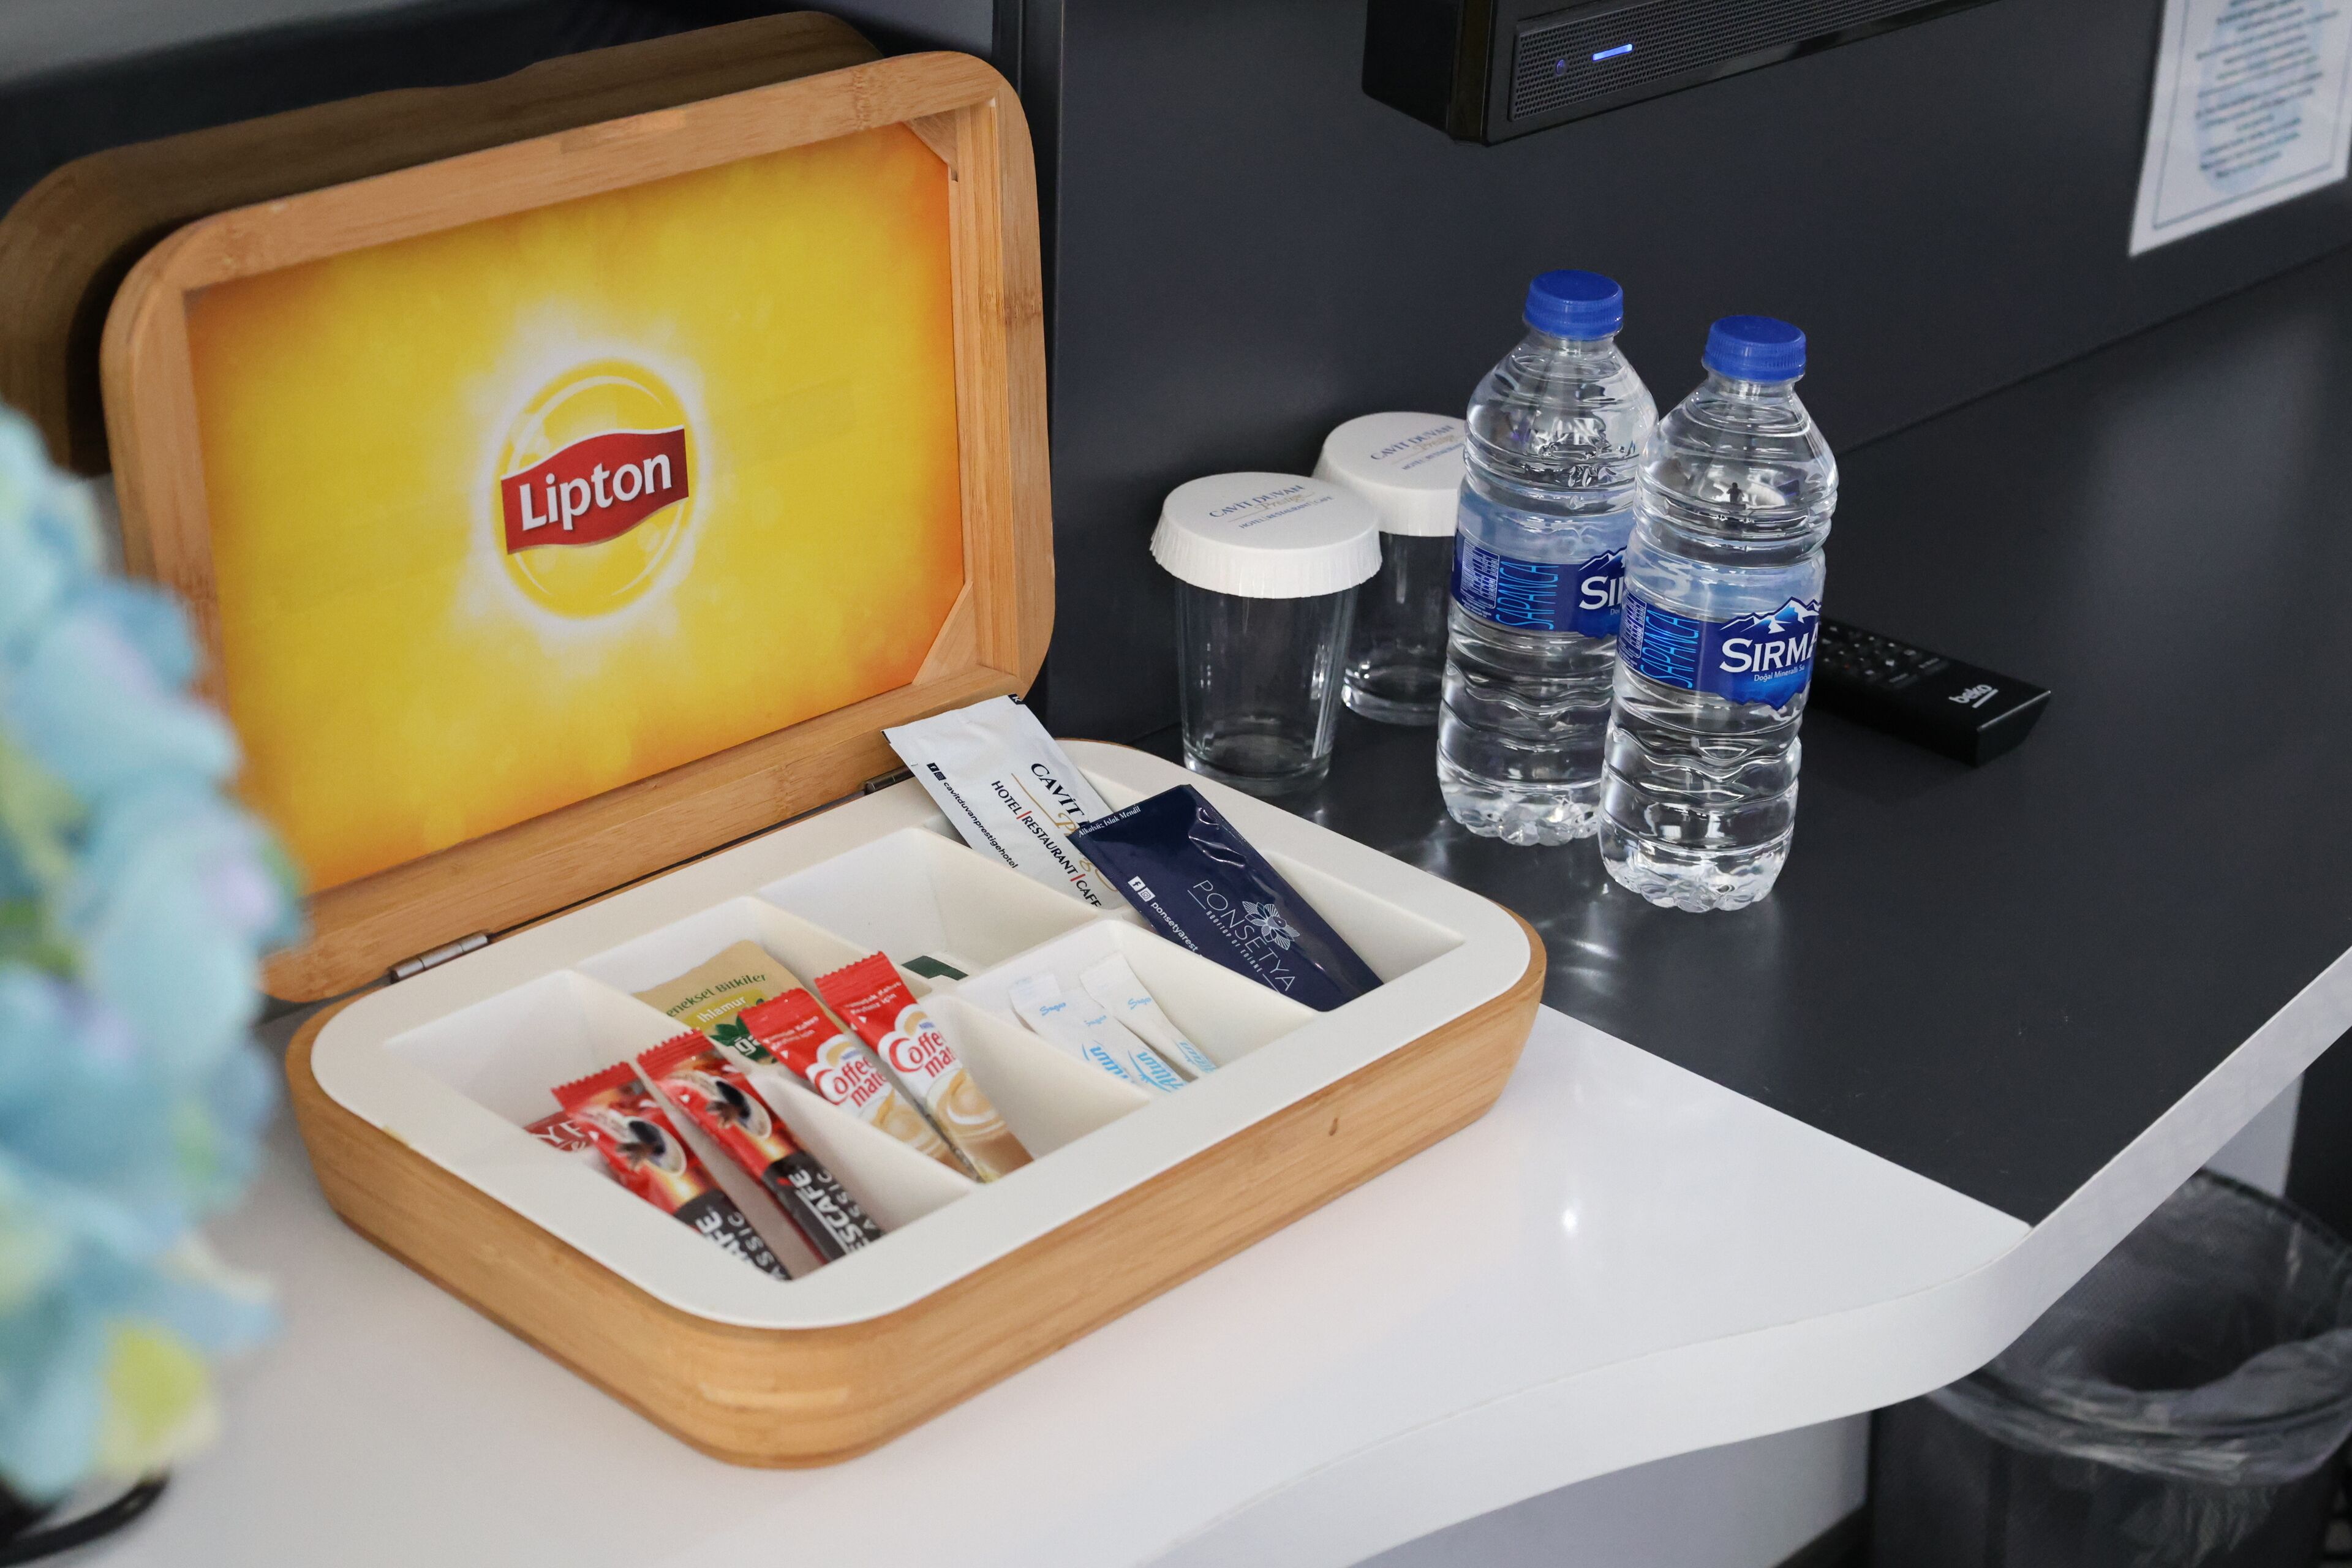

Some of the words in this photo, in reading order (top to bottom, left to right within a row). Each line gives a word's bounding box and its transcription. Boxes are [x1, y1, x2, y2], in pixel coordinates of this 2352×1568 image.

[519, 454, 672, 531] Lipton
[1252, 485, 1305, 503] DUVAN
[1496, 561, 1559, 630] SAPANCA
[1640, 609, 1700, 688] SAPANCA
[1754, 673, 1773, 682] Doğal
[1948, 684, 1992, 704] beko
[943, 782, 1019, 869] cavitduvanprestigehotel
[991, 780, 1022, 815] HOTEL
[1022, 815, 1079, 875] RESTAURANT
[1118, 805, 1141, 820] Mendil
[1193, 880, 1295, 991] PONSETYA
[666, 988, 715, 1017] eneksel
[714, 974, 766, 993] Bitkiler
